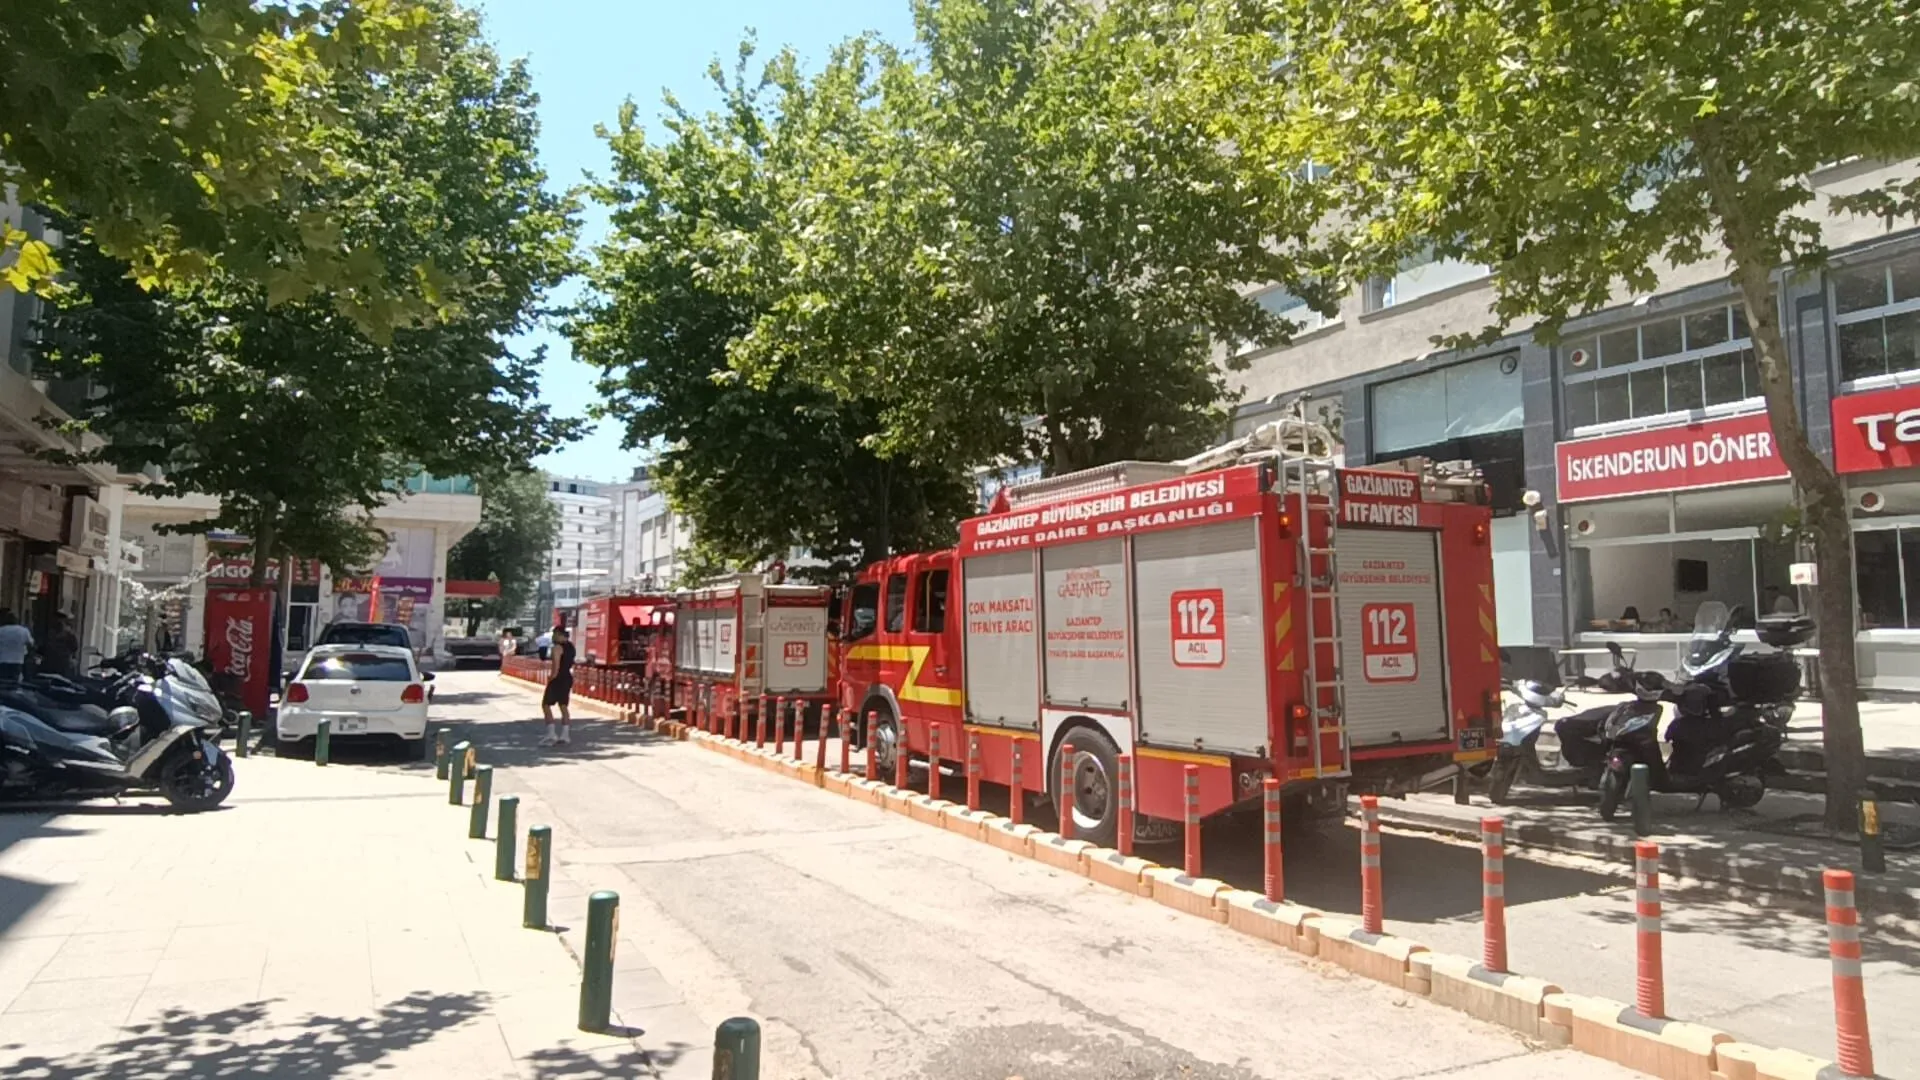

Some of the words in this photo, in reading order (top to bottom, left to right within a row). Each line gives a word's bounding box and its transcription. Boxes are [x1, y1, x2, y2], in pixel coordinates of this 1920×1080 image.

[1567, 444, 1687, 482] İSKENDERUN
[1693, 432, 1772, 467] DÖNER
[1345, 473, 1414, 497] GAZİANTEP
[977, 511, 1039, 536] GAZİANTEP
[1042, 494, 1126, 525] BÜYÜKŞEHİR
[1130, 473, 1225, 509] BELEDİYESİ
[1344, 500, 1418, 527] İTFAİYESİ
[973, 534, 1030, 551] İTFAİYE
[1035, 525, 1088, 543] DAİRE
[1096, 501, 1234, 533] BAŞKANLIĞI
[968, 602, 986, 615] ÇOK
[989, 598, 1034, 613] MAKSATLI
[1178, 598, 1217, 635] 112
[1005, 619, 1033, 633] ARACI
[1368, 607, 1408, 646] 112
[787, 644, 806, 657] 112
